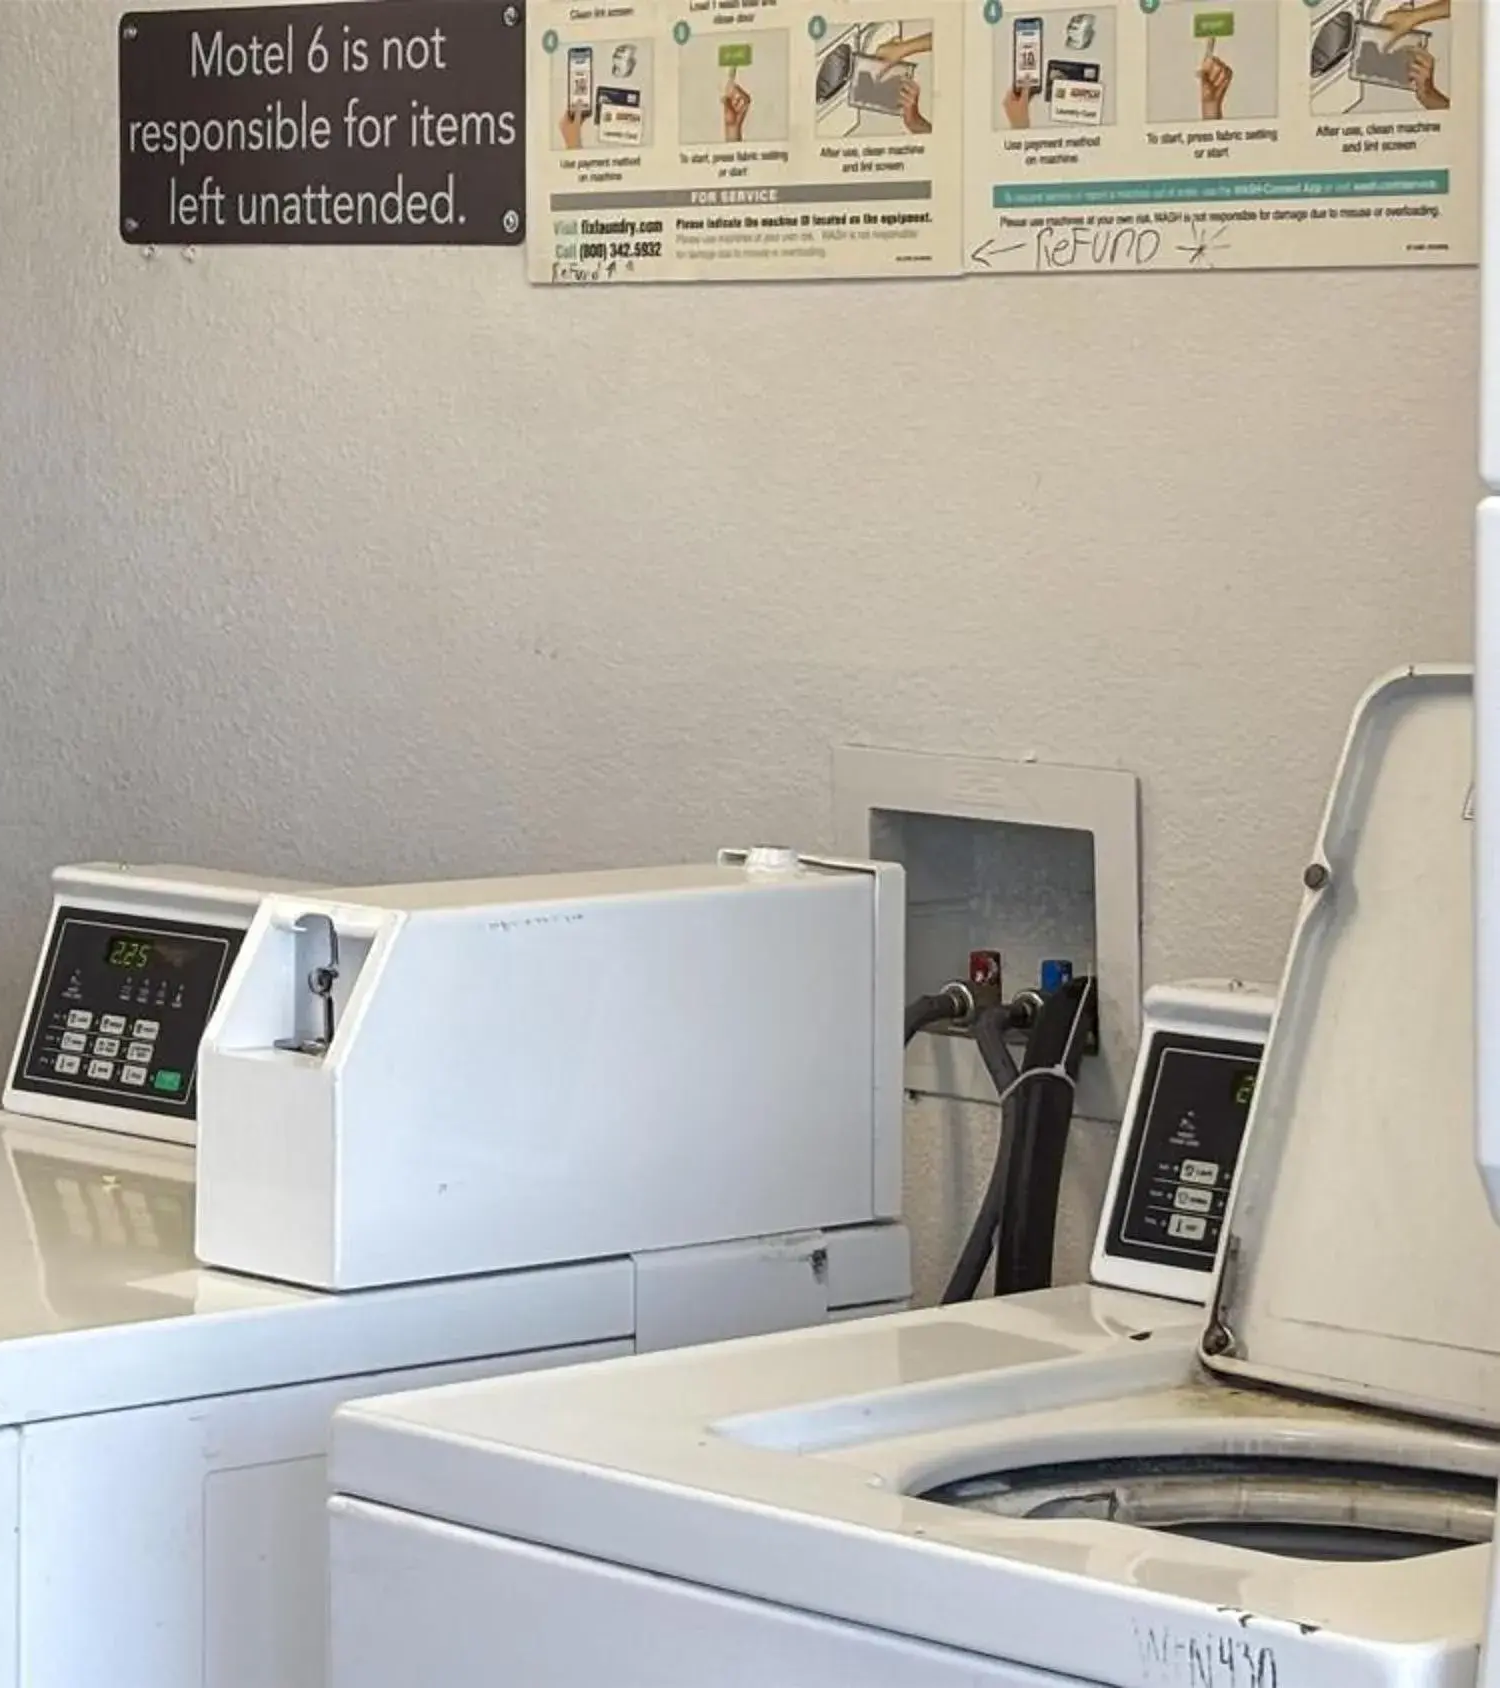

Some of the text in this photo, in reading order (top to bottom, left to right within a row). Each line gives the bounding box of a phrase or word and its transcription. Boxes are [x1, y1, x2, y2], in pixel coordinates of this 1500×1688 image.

[191, 24, 447, 78] Motel 6 is not
[129, 98, 517, 166] responsible for items
[169, 173, 467, 227] left unattended.
[691, 189, 779, 204] FOR SERVICE
[581, 218, 663, 237] fixlaundry.com
[676, 218, 704, 229] Please
[706, 217, 742, 229] indicate
[761, 215, 798, 227] machine
[812, 213, 846, 226] located
[555, 241, 662, 262] Call (800) 342.5932
